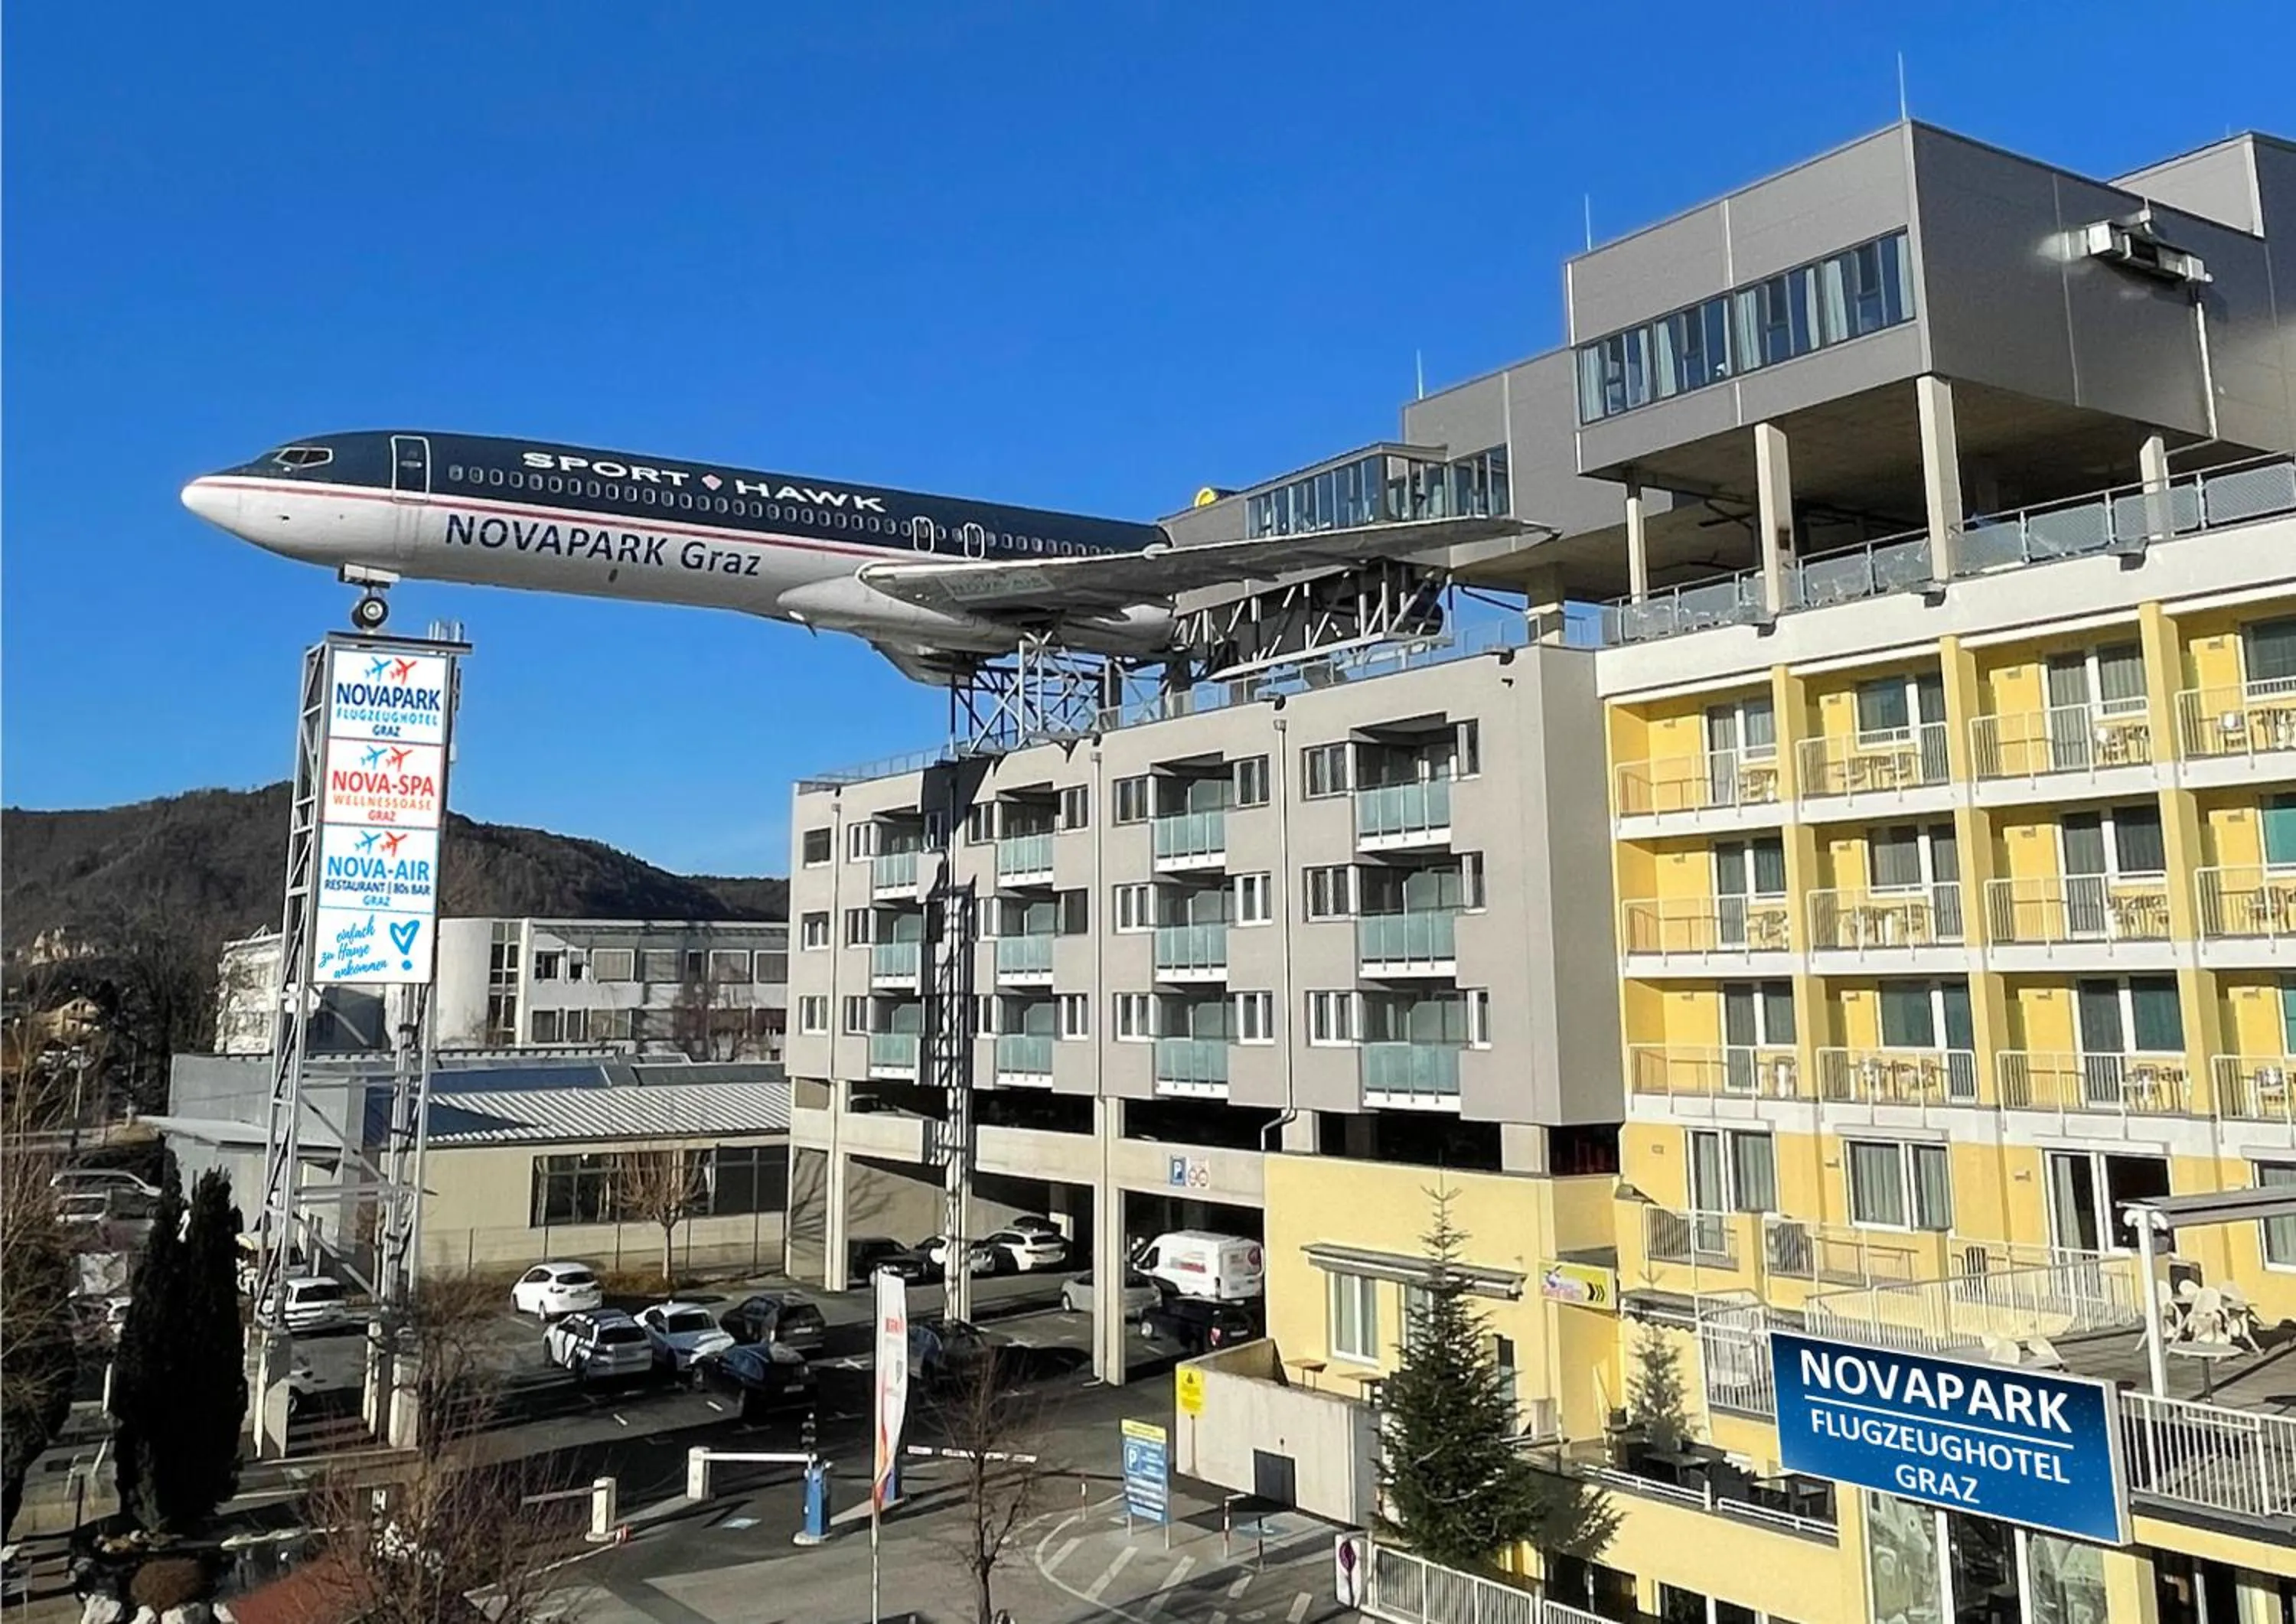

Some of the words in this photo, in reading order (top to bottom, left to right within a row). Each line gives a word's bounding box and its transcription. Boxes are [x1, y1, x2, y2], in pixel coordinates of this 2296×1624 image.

[521, 452, 689, 487] SPORT
[735, 478, 887, 514] HAWK
[445, 514, 668, 566] NOVAPARK
[680, 541, 762, 576] Graz
[336, 683, 441, 712] NOVAPARK
[337, 707, 438, 726] FLUGZEUGHOTEL
[372, 723, 400, 738] GRAZ
[332, 770, 434, 797] NOVA-SPA
[333, 794, 432, 810] WELLNESSOASE
[368, 810, 396, 822] GRAZ
[328, 856, 430, 882] NOVA-AIR
[325, 879, 386, 893] RESTAURANT
[393, 883, 409, 894] 80s
[411, 884, 431, 895] BAR
[363, 895, 391, 906] GRAZ
[336, 914, 376, 944] einfach
[338, 942, 370, 961] Hause
[333, 959, 388, 979] ankommen
[1800, 1348, 2072, 1434] NOVAPARK
[1811, 1408, 2070, 1484] FLUGZEUGHOTEL
[1895, 1463, 1981, 1504] GRAZ
